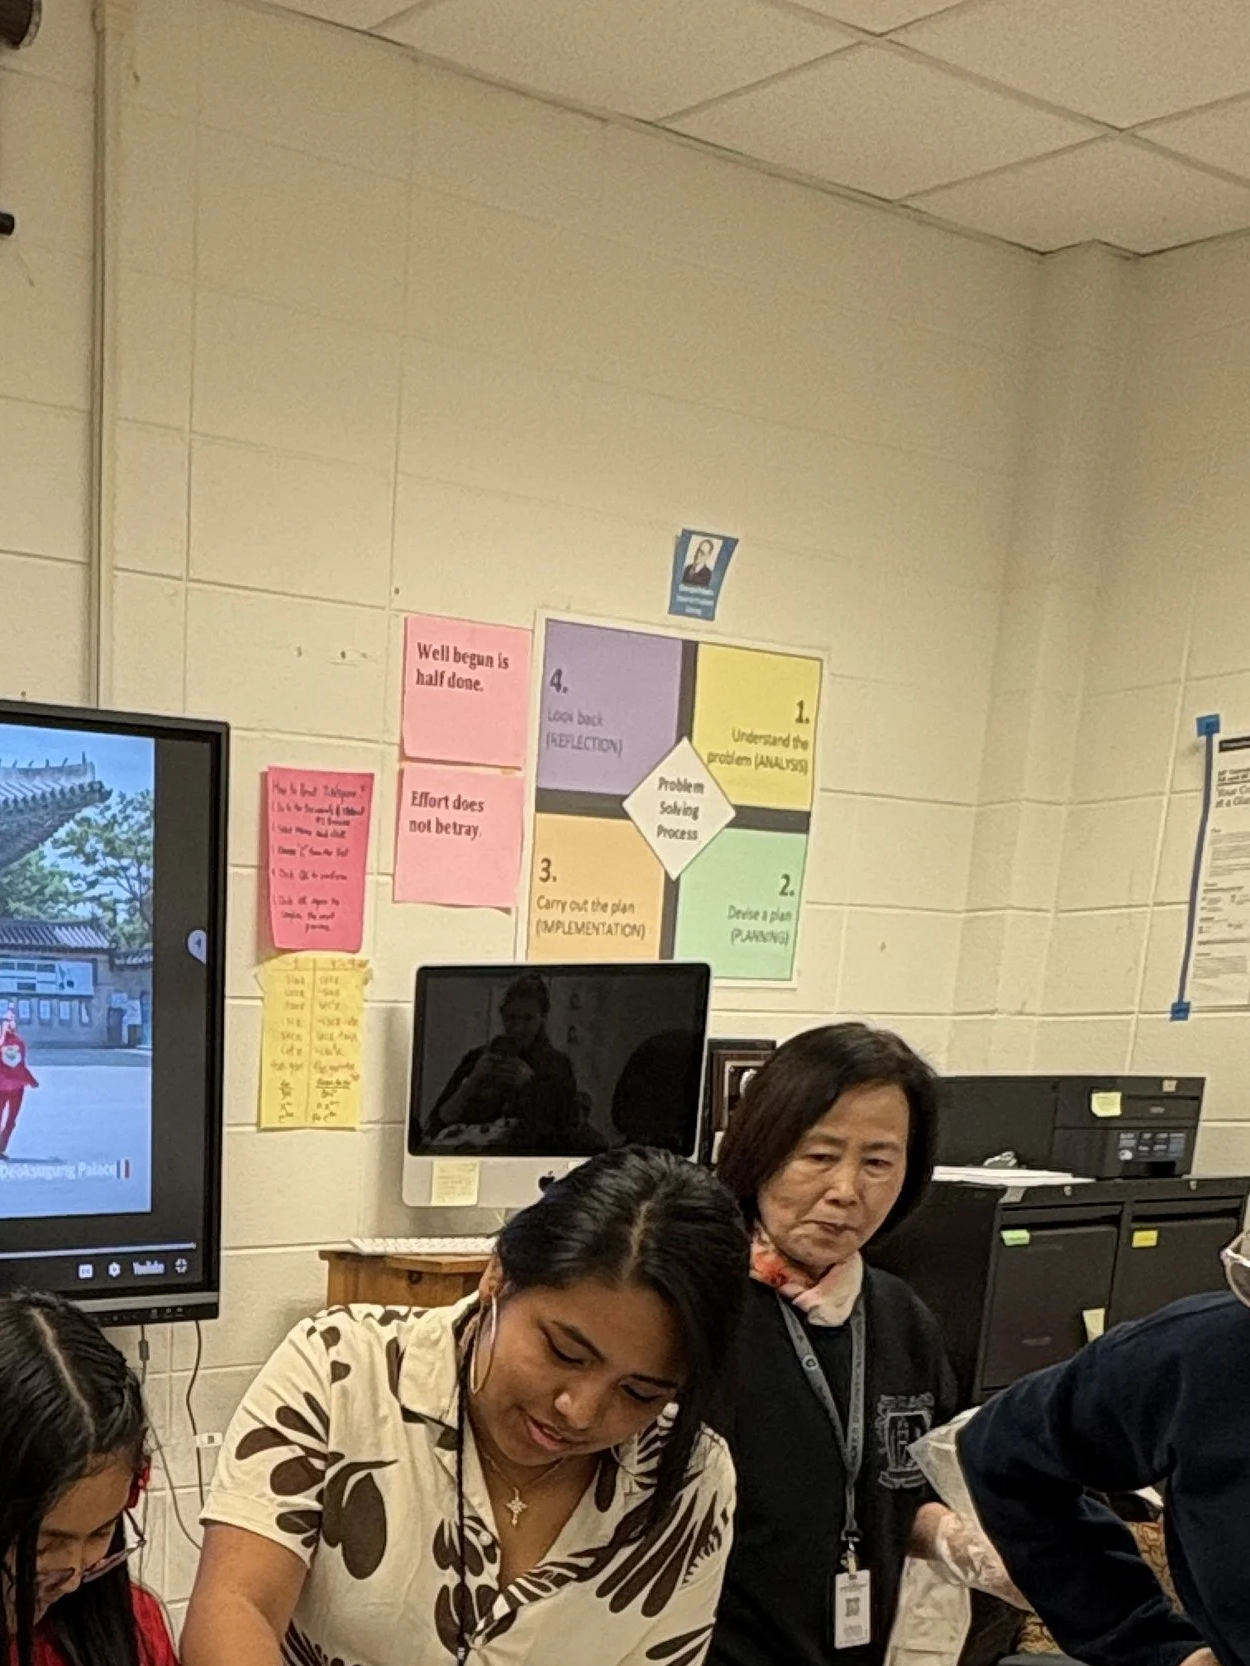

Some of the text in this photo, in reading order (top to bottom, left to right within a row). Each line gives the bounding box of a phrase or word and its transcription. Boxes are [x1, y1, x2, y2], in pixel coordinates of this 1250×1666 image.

[417, 642, 510, 671] Well begun is
[415, 668, 485, 692] half done.
[550, 668, 569, 694] 4.
[547, 709, 603, 727] Look back
[794, 699, 810, 724] 1.
[546, 731, 623, 758] (REFLECTION)
[731, 727, 809, 751] Understand the
[707, 750, 808, 776] problem (ANALYSIS)
[657, 776, 705, 795] Problem
[410, 790, 485, 813] Effort does
[659, 800, 700, 821] Solving
[409, 816, 482, 841] not betray.
[656, 824, 698, 840] Process
[538, 857, 557, 883] 3.
[779, 873, 795, 897] 2.
[536, 894, 635, 918] Carry out the plan
[727, 904, 792, 924] Devise a plan
[535, 917, 646, 941] (IMPLEMENTATION)
[731, 927, 790, 946] (PLANNING)
